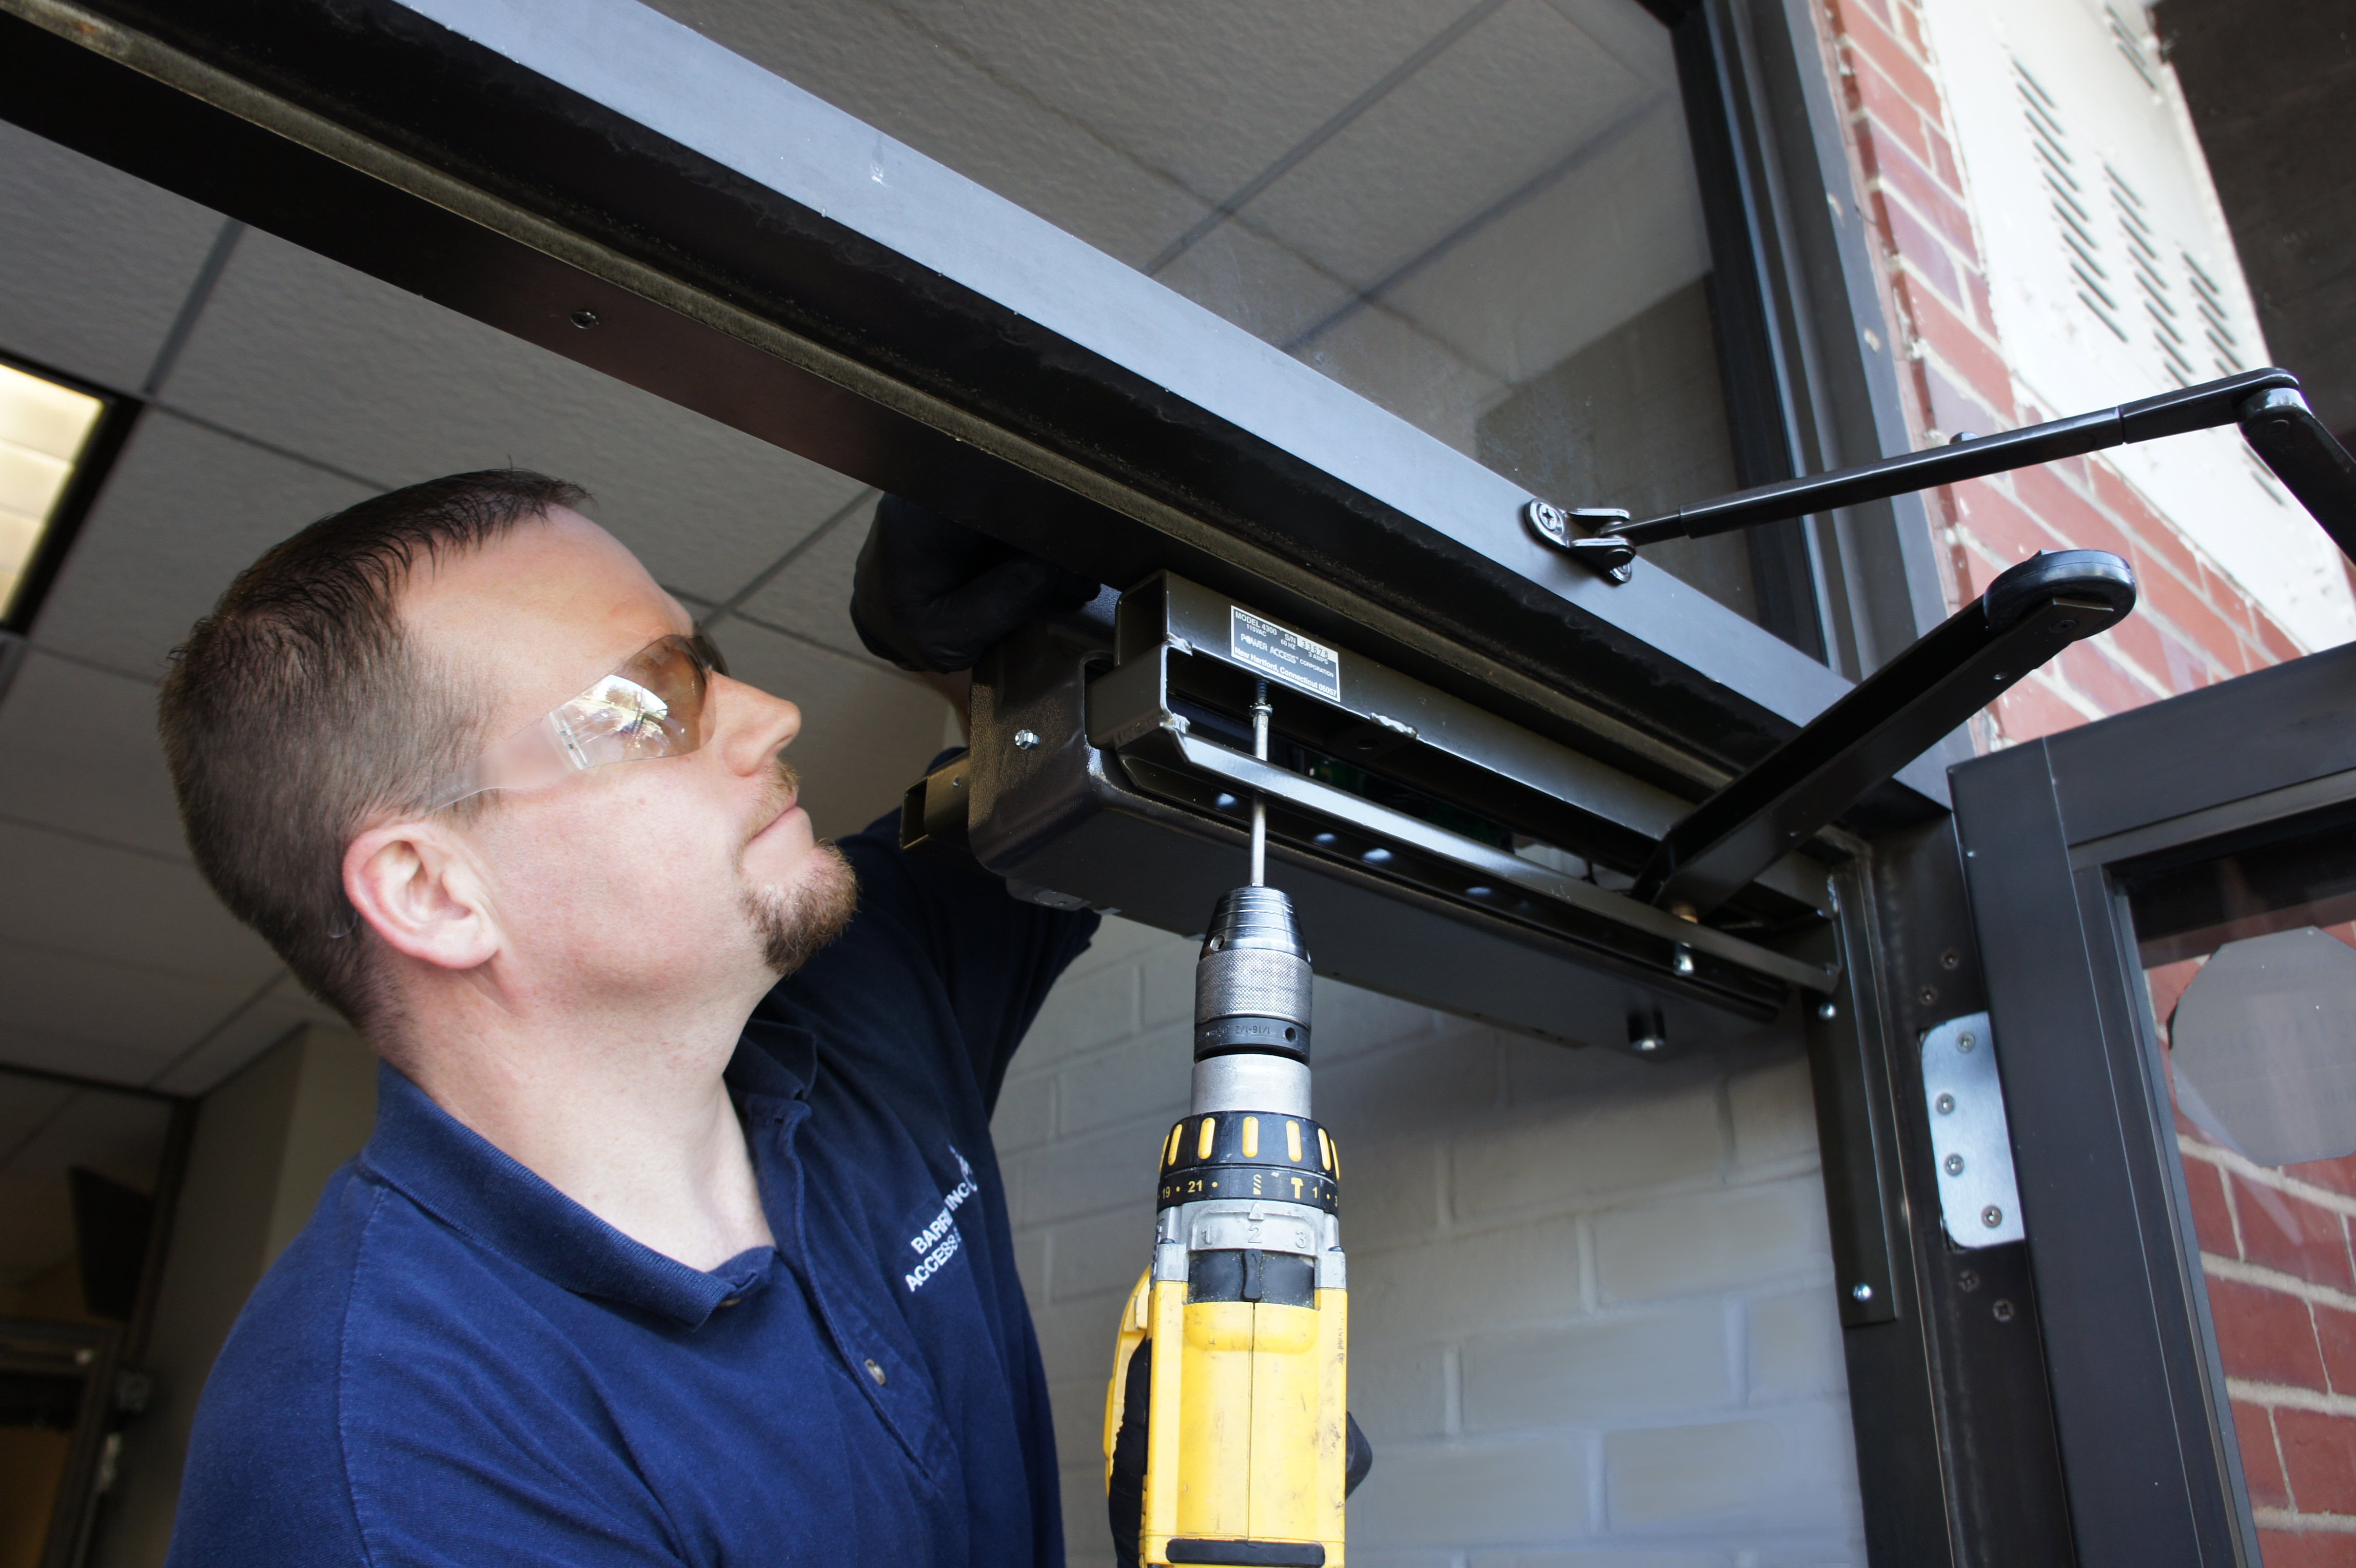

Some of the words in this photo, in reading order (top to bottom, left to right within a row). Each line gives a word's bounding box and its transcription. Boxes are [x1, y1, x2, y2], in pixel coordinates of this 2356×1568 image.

[1235, 611, 1260, 629] MODEL
[1261, 623, 1277, 636] 4300
[1284, 634, 1297, 644] S/N
[1302, 640, 1328, 659] 33678
[1241, 633, 1268, 652] POWER
[1300, 659, 1334, 678] CORPORATION
[1246, 624, 1267, 637] 115VAC
[1312, 654, 1329, 665] AMPS
[1234, 646, 1250, 660] New
[1250, 653, 1279, 672] Hartford,
[1280, 667, 1318, 689] Connecticut
[1318, 683, 1337, 696] 06057
[1162, 1186, 1171, 1199] 19
[1188, 1180, 1203, 1193] 21
[1312, 1186, 1318, 1199] 1
[1248, 1225, 1262, 1244] 2
[1294, 1230, 1307, 1249] 3
